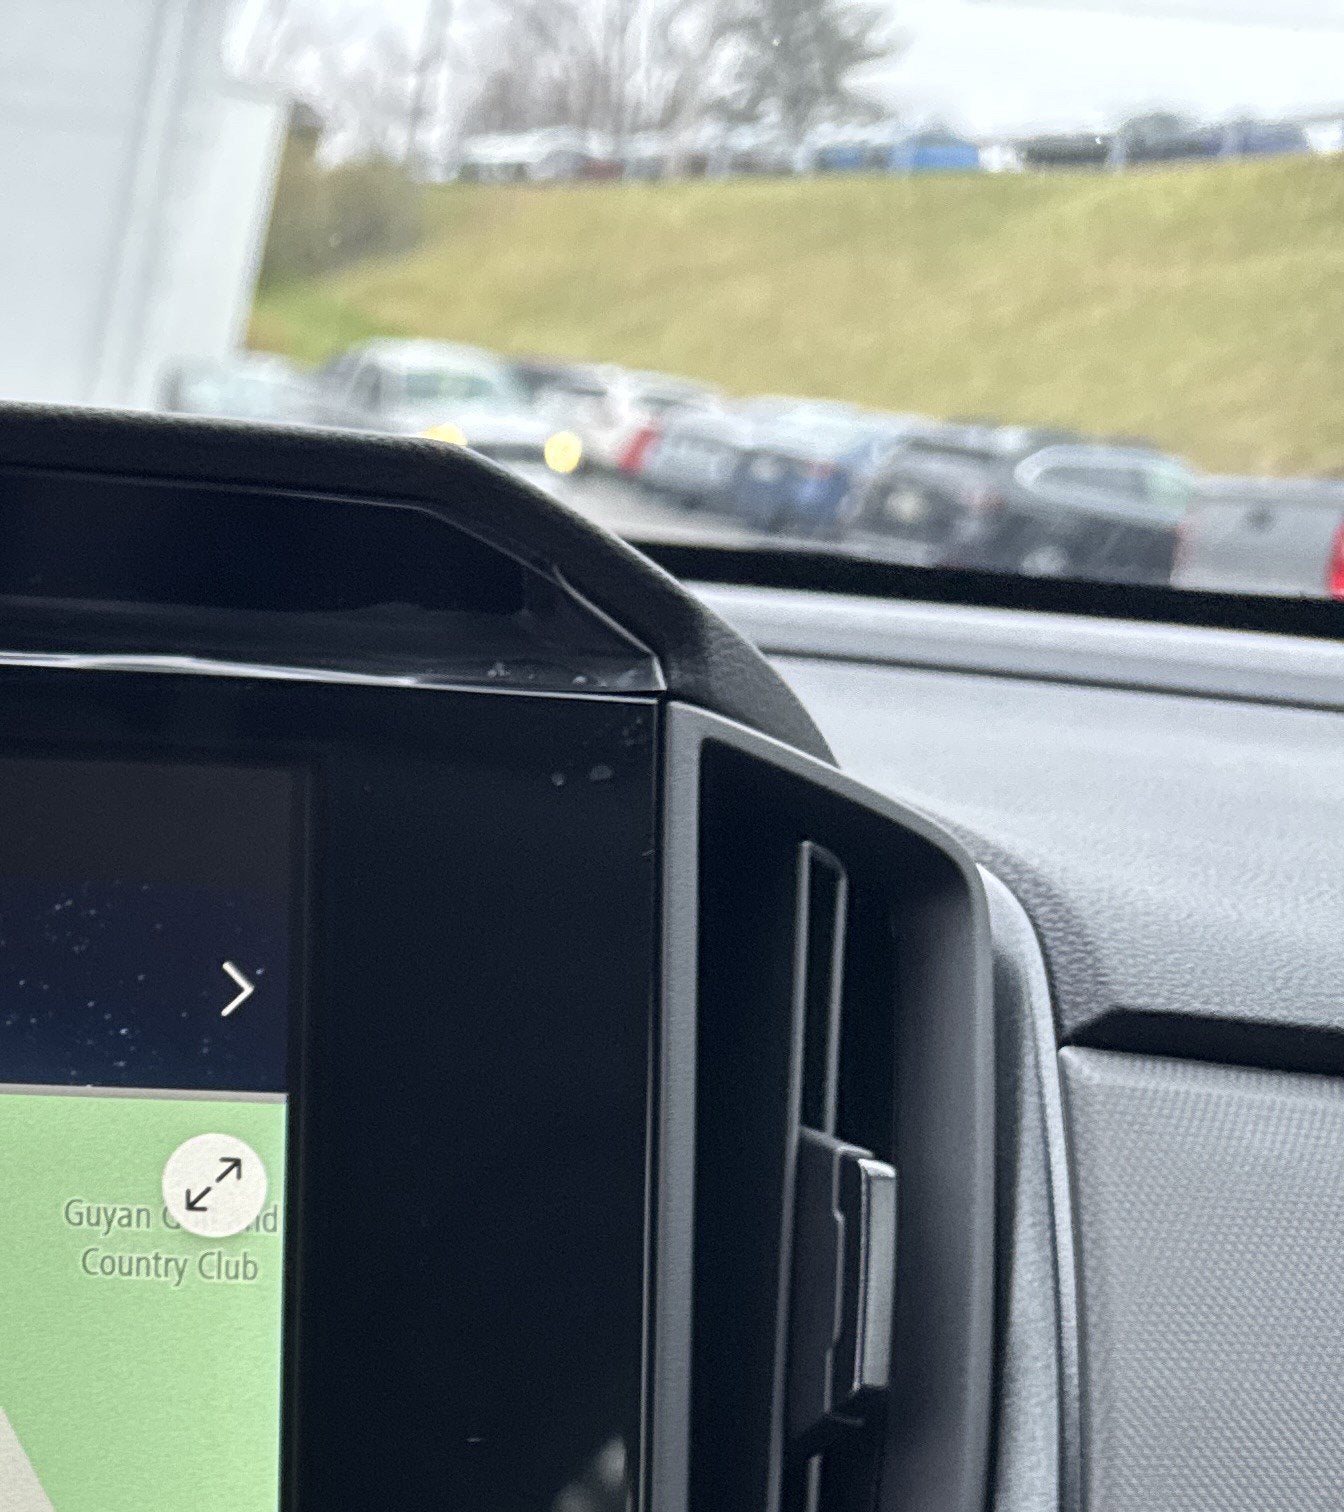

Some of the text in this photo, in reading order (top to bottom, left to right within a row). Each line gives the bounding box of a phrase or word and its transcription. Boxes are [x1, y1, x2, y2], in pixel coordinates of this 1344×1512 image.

[64, 1199, 151, 1237] Guyan
[81, 1247, 259, 1287] Country Club
